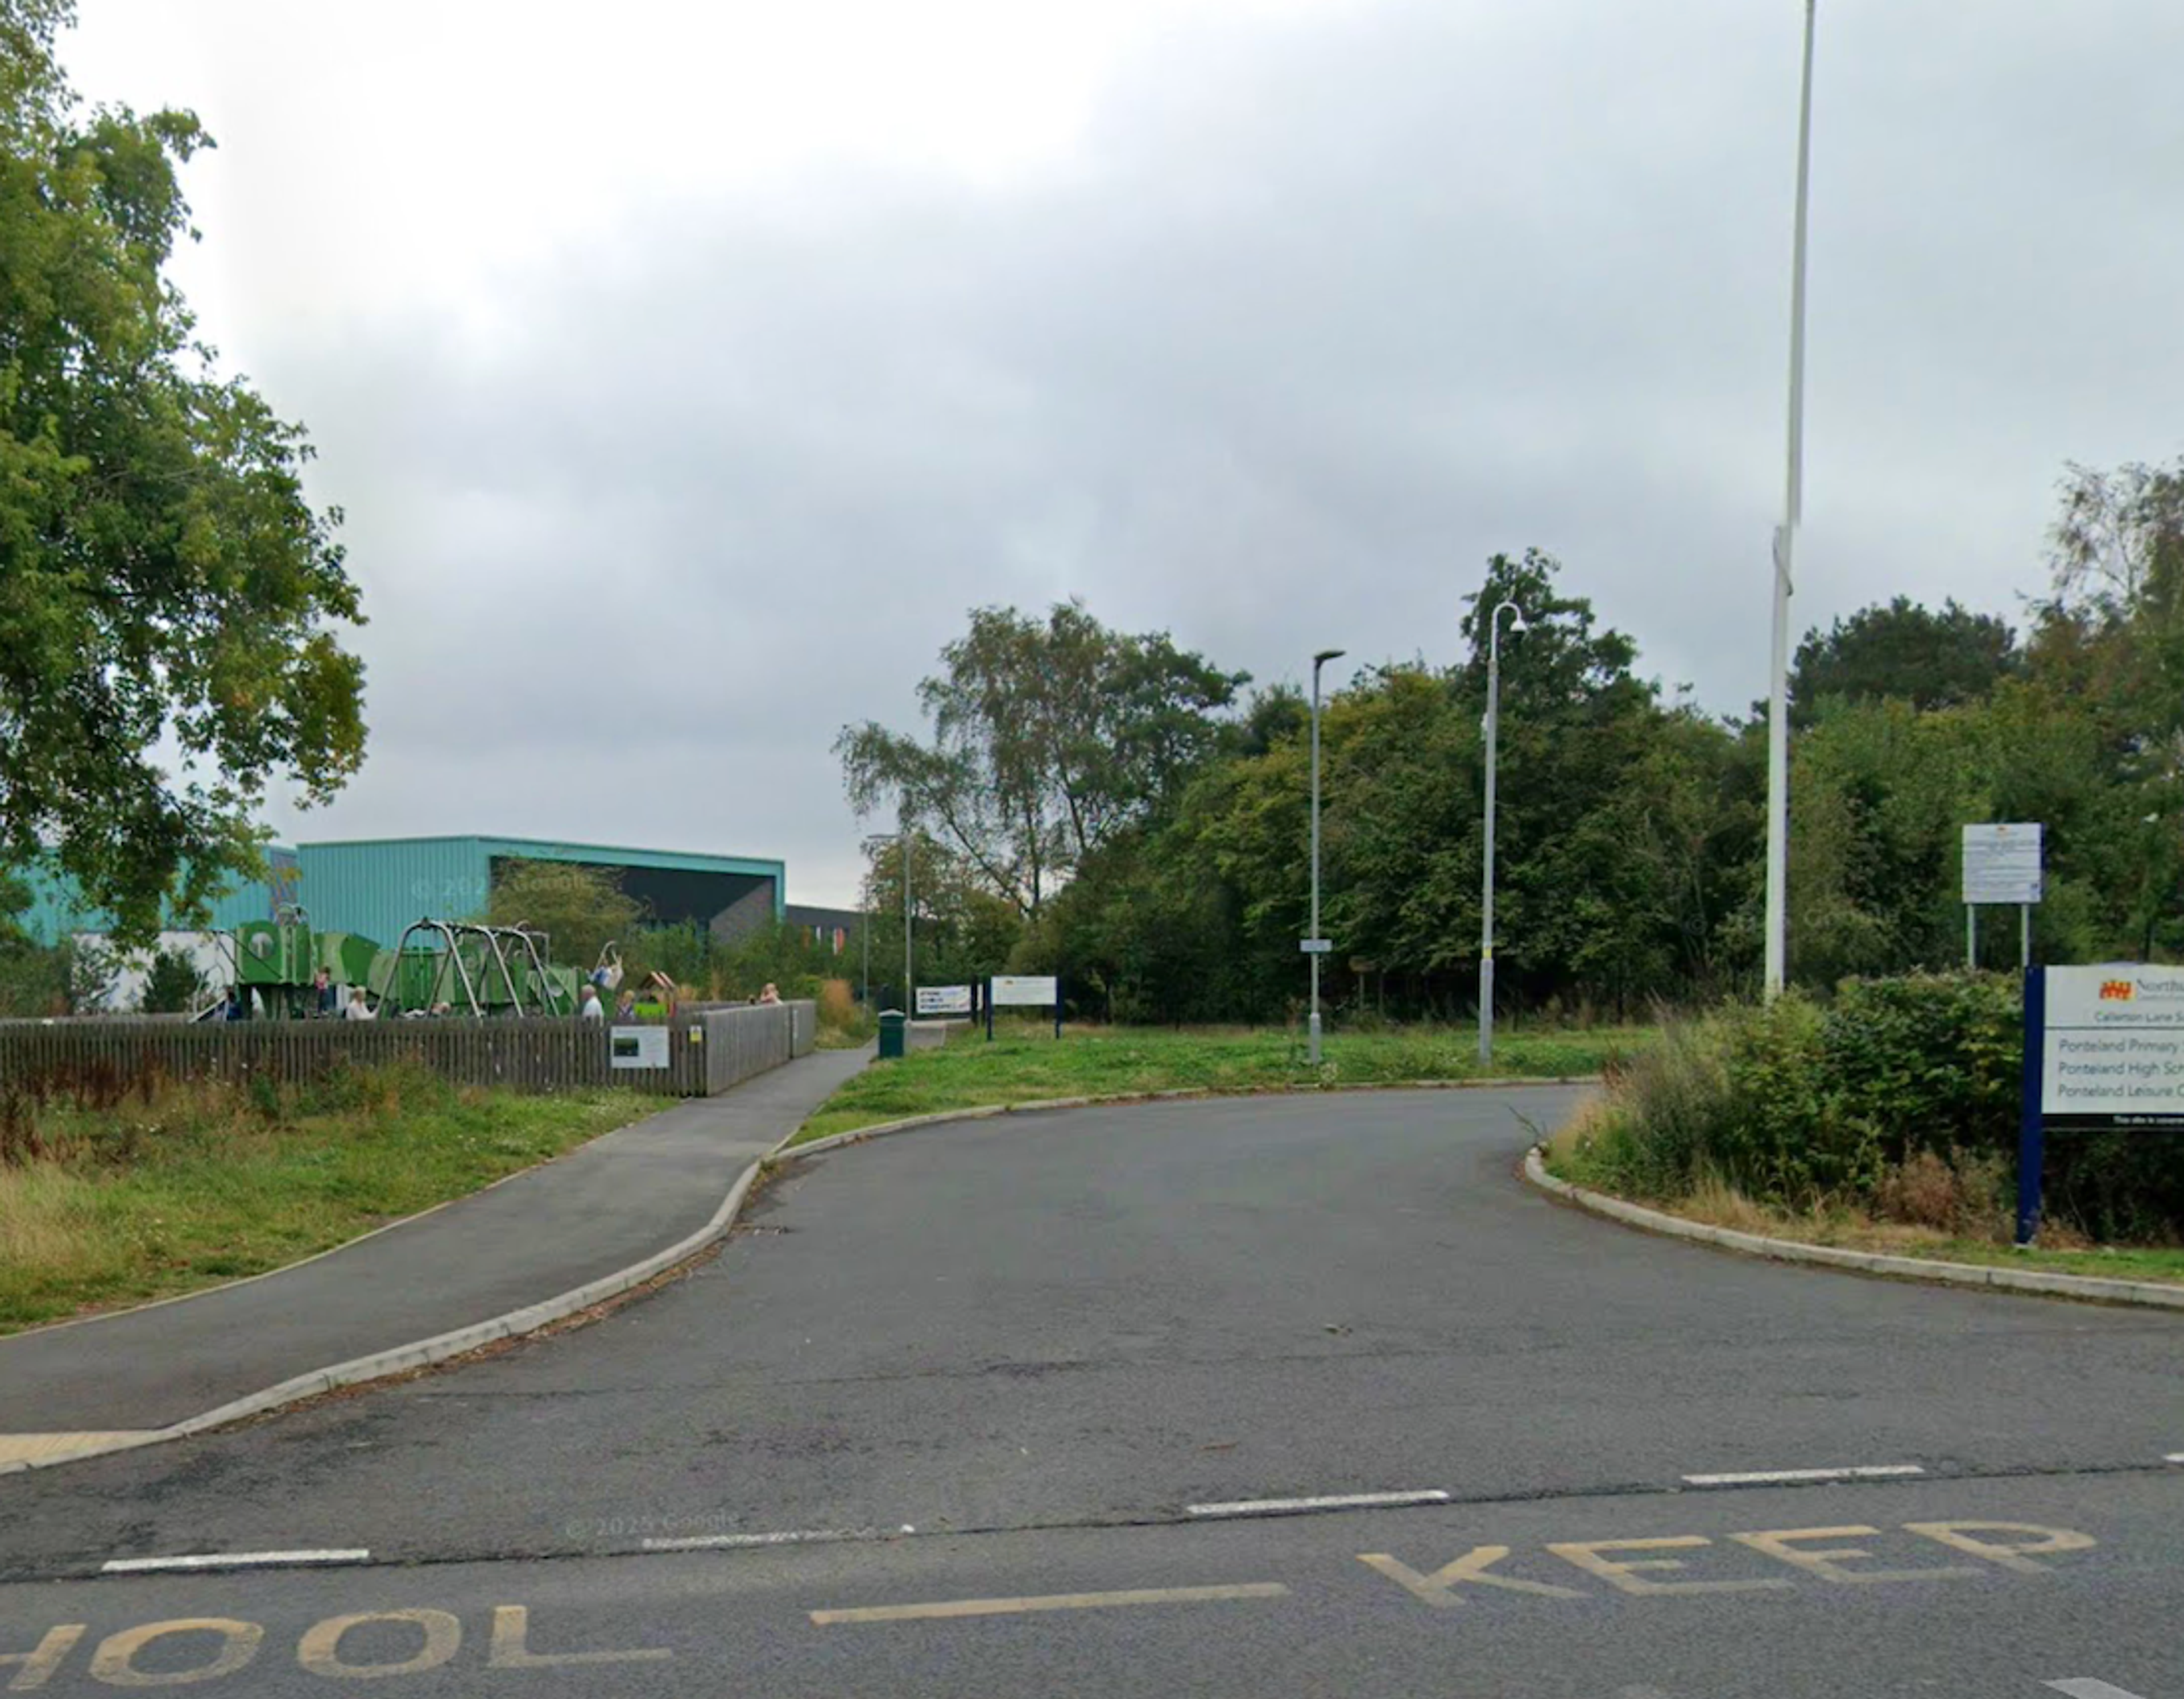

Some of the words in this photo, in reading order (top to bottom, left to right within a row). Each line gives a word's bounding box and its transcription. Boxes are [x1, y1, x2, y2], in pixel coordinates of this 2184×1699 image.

[2059, 1039, 2124, 1052] Ponteland
[2129, 1038, 2178, 1055] Primary
[2059, 1062, 2124, 1075] Ponteland
[2128, 1062, 2160, 1079] High
[2058, 1084, 2124, 1097] Ponteland
[2128, 1083, 2173, 1097] Leisure
[1356, 1521, 2098, 1607] KEEP
